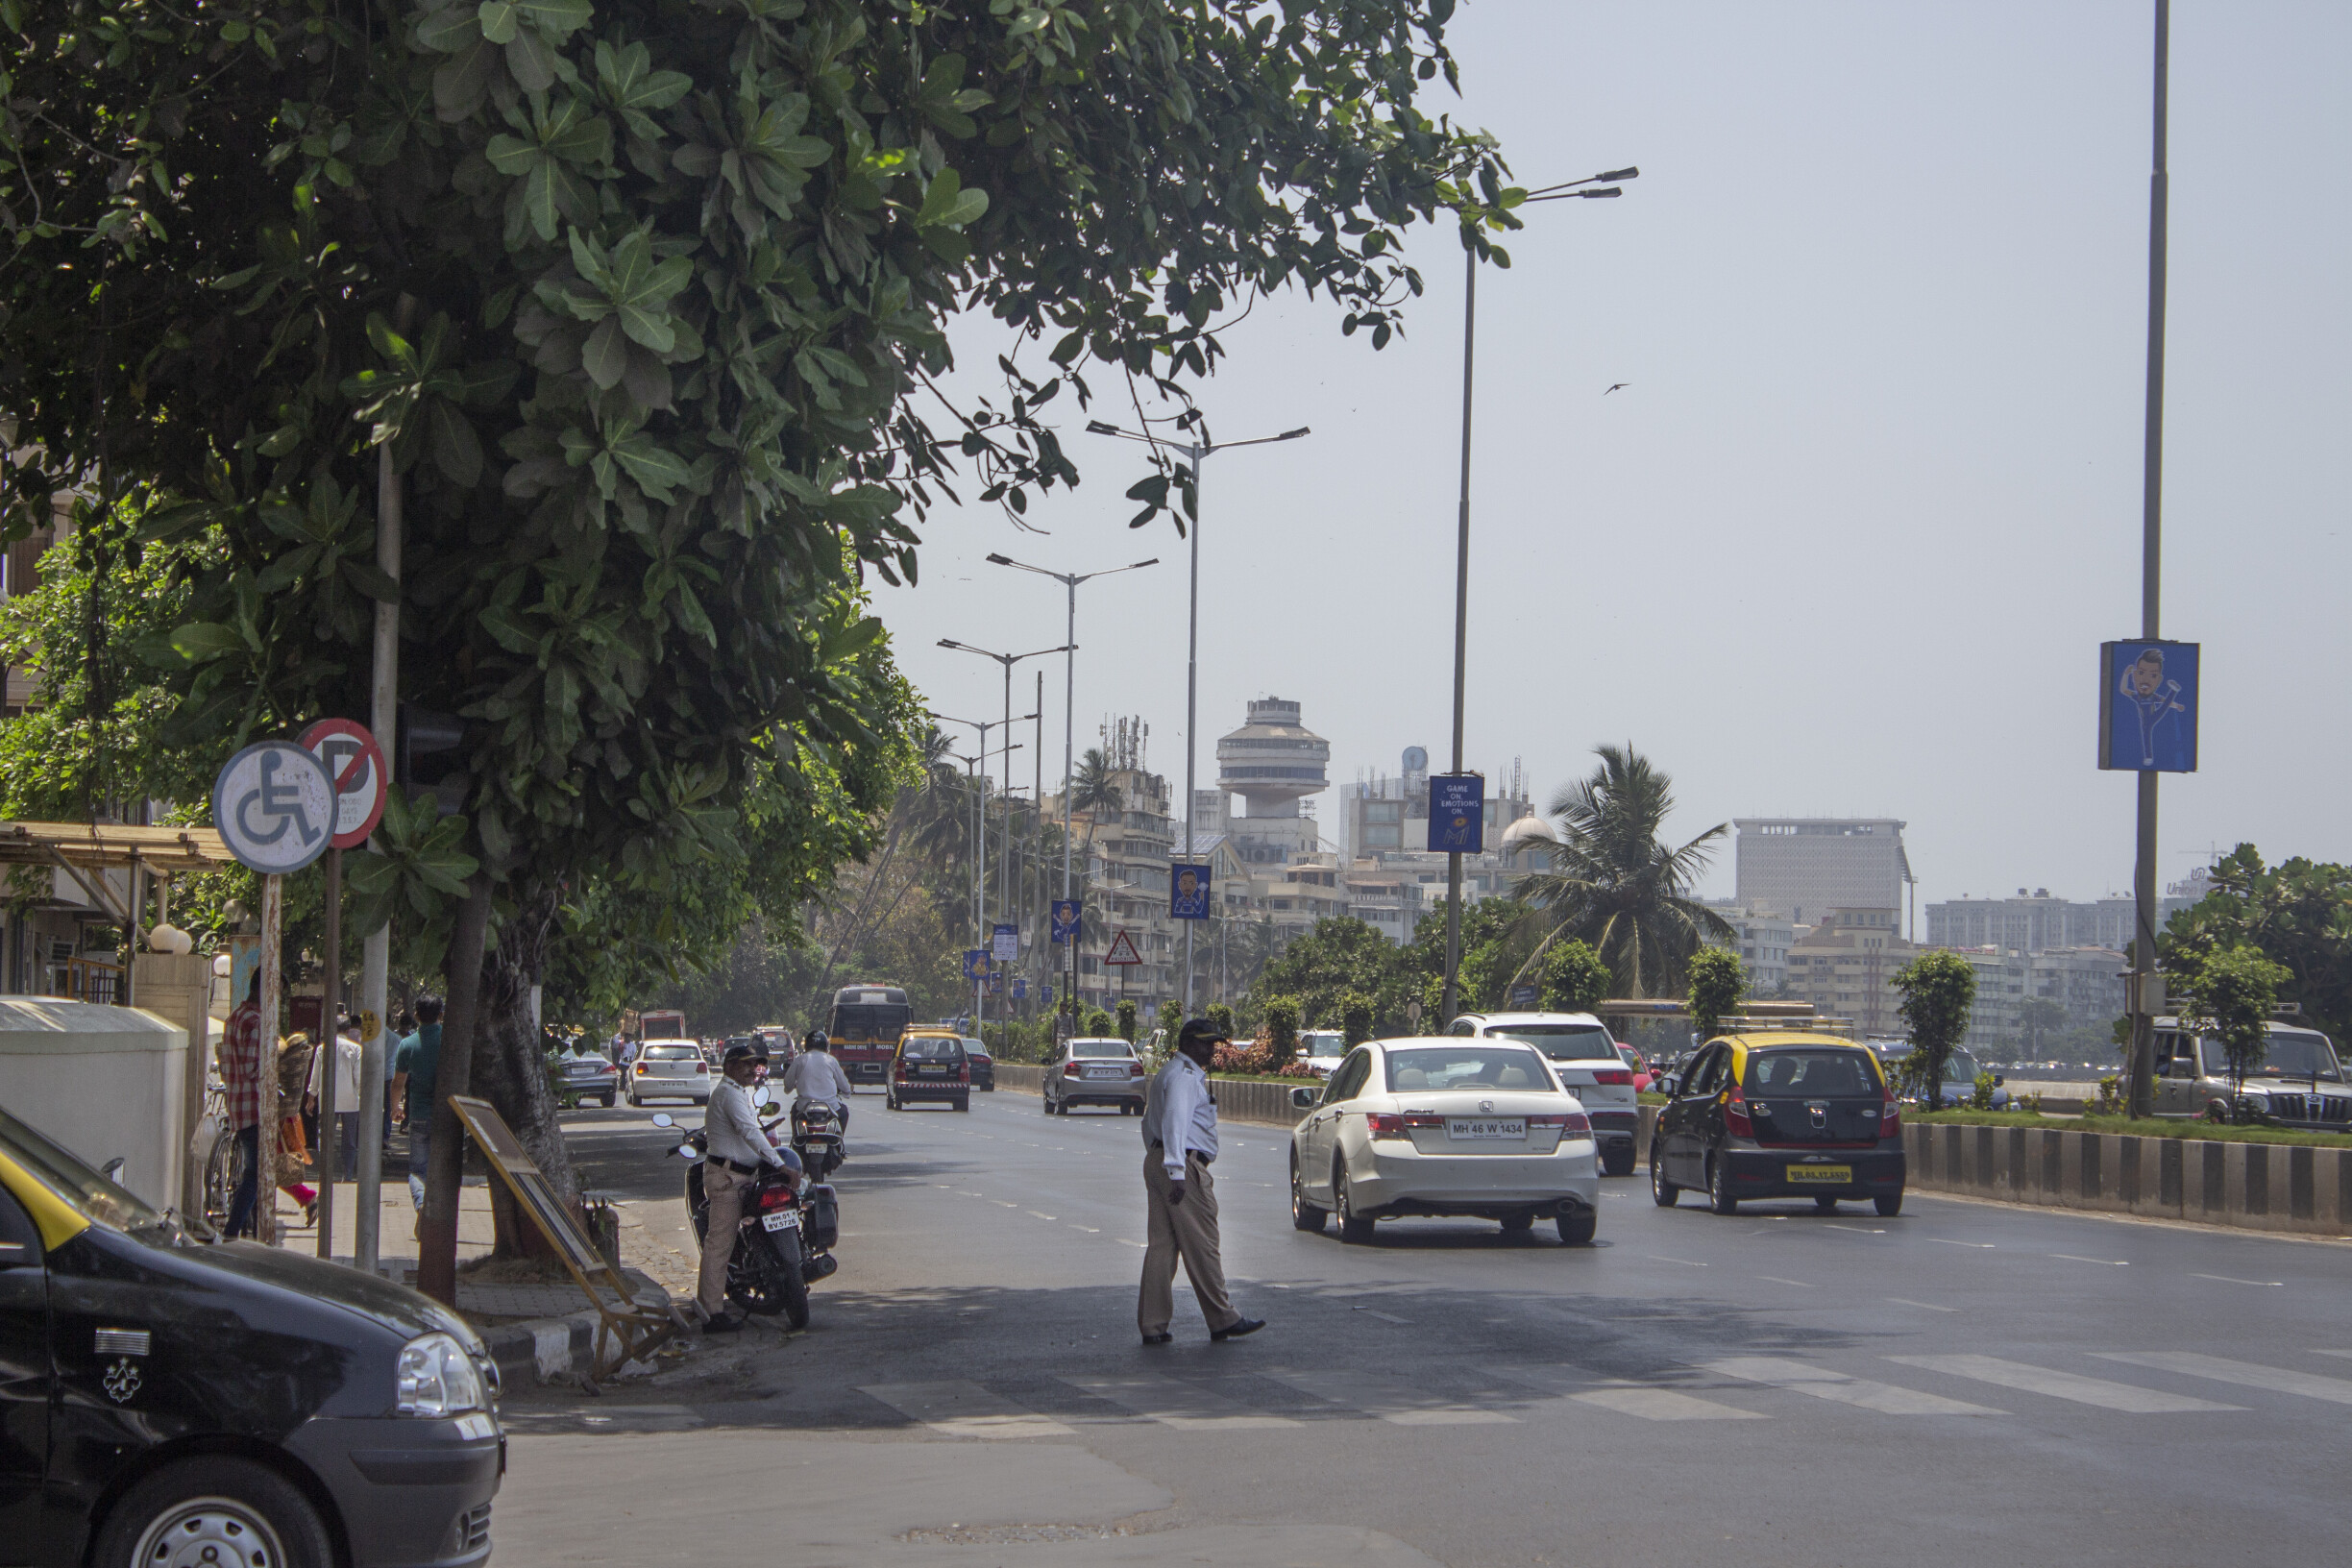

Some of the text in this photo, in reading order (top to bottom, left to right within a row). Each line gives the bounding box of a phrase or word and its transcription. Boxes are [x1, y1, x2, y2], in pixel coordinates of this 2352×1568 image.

[1446, 784, 1469, 793] GAME
[2167, 882, 2197, 895] Union
[1453, 1123, 1523, 1134] MH 46 W 1434
